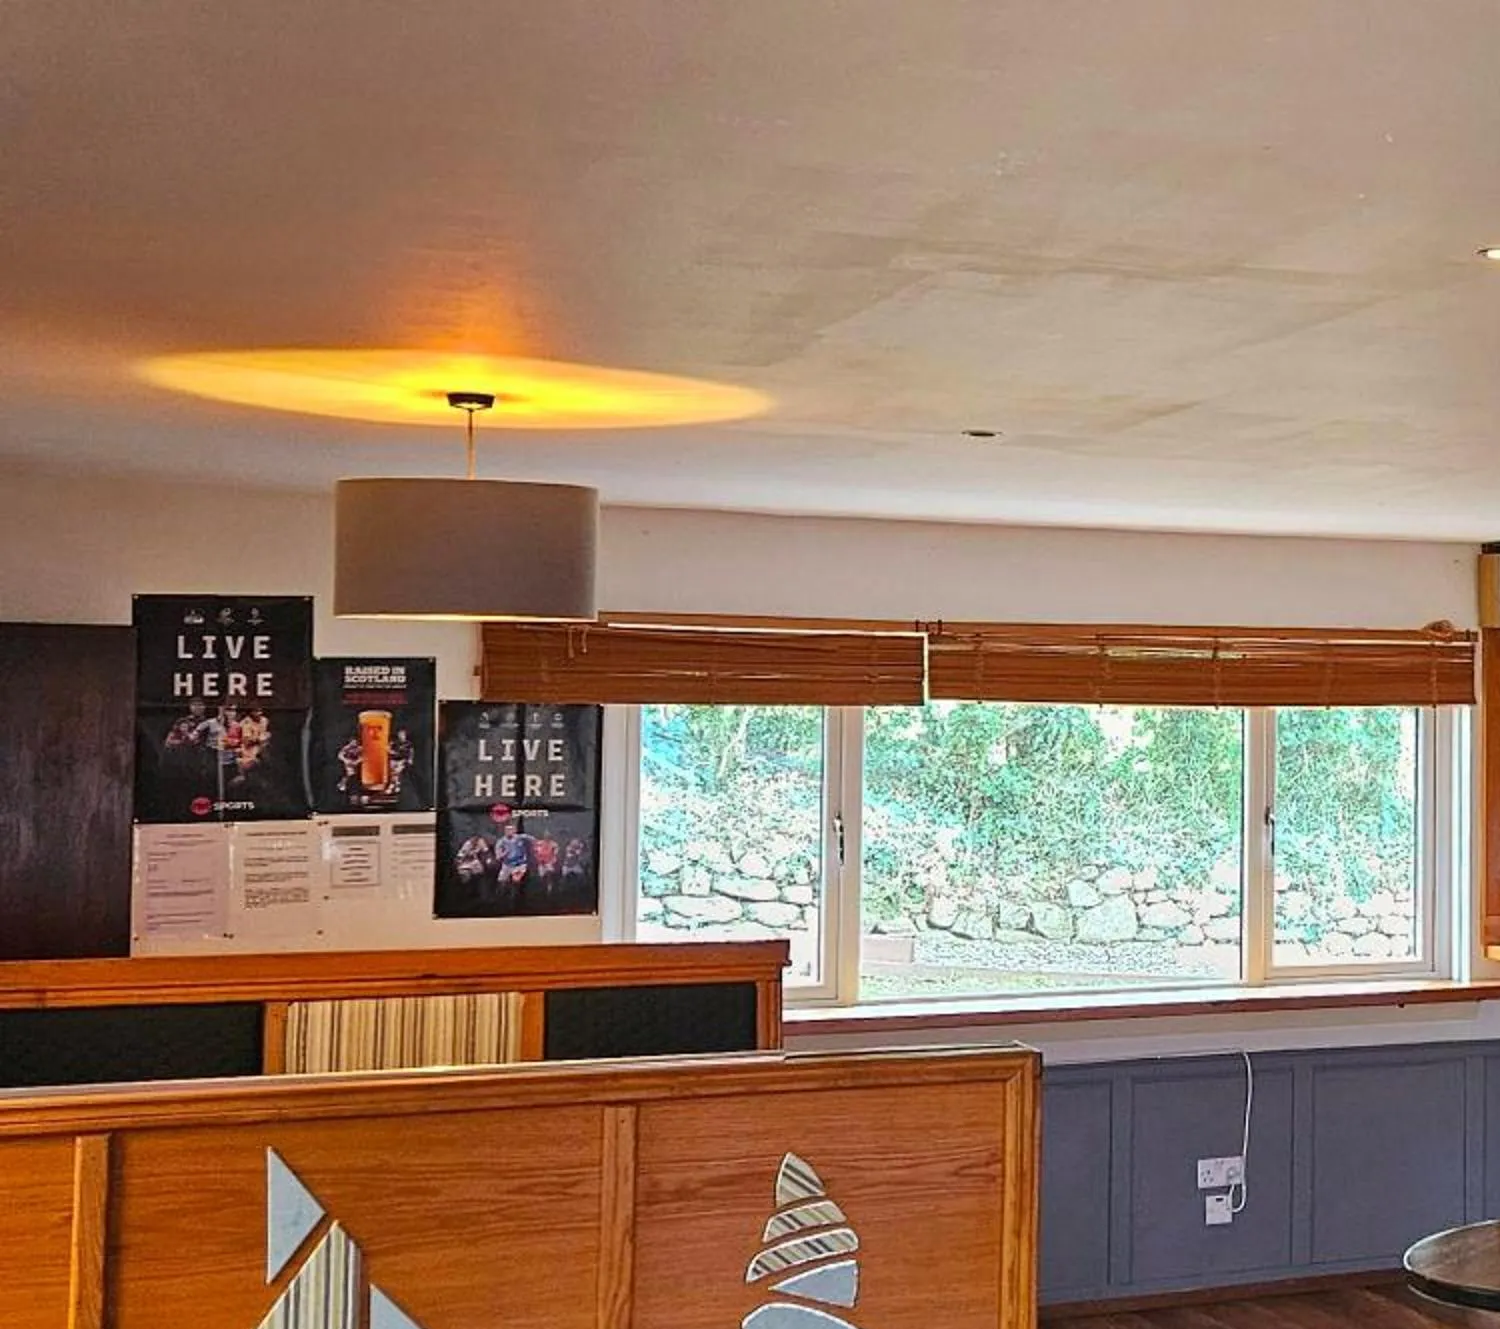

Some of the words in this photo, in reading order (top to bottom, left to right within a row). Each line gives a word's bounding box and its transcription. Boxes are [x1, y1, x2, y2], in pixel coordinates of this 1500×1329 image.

[176, 635, 272, 660] LIVE
[173, 672, 274, 697] HERE
[344, 675, 407, 683] SCOTLAND
[477, 739, 565, 761] LIVE
[474, 774, 566, 797] HERE
[212, 801, 255, 811] SPORTS
[511, 809, 549, 818] SPORTS
